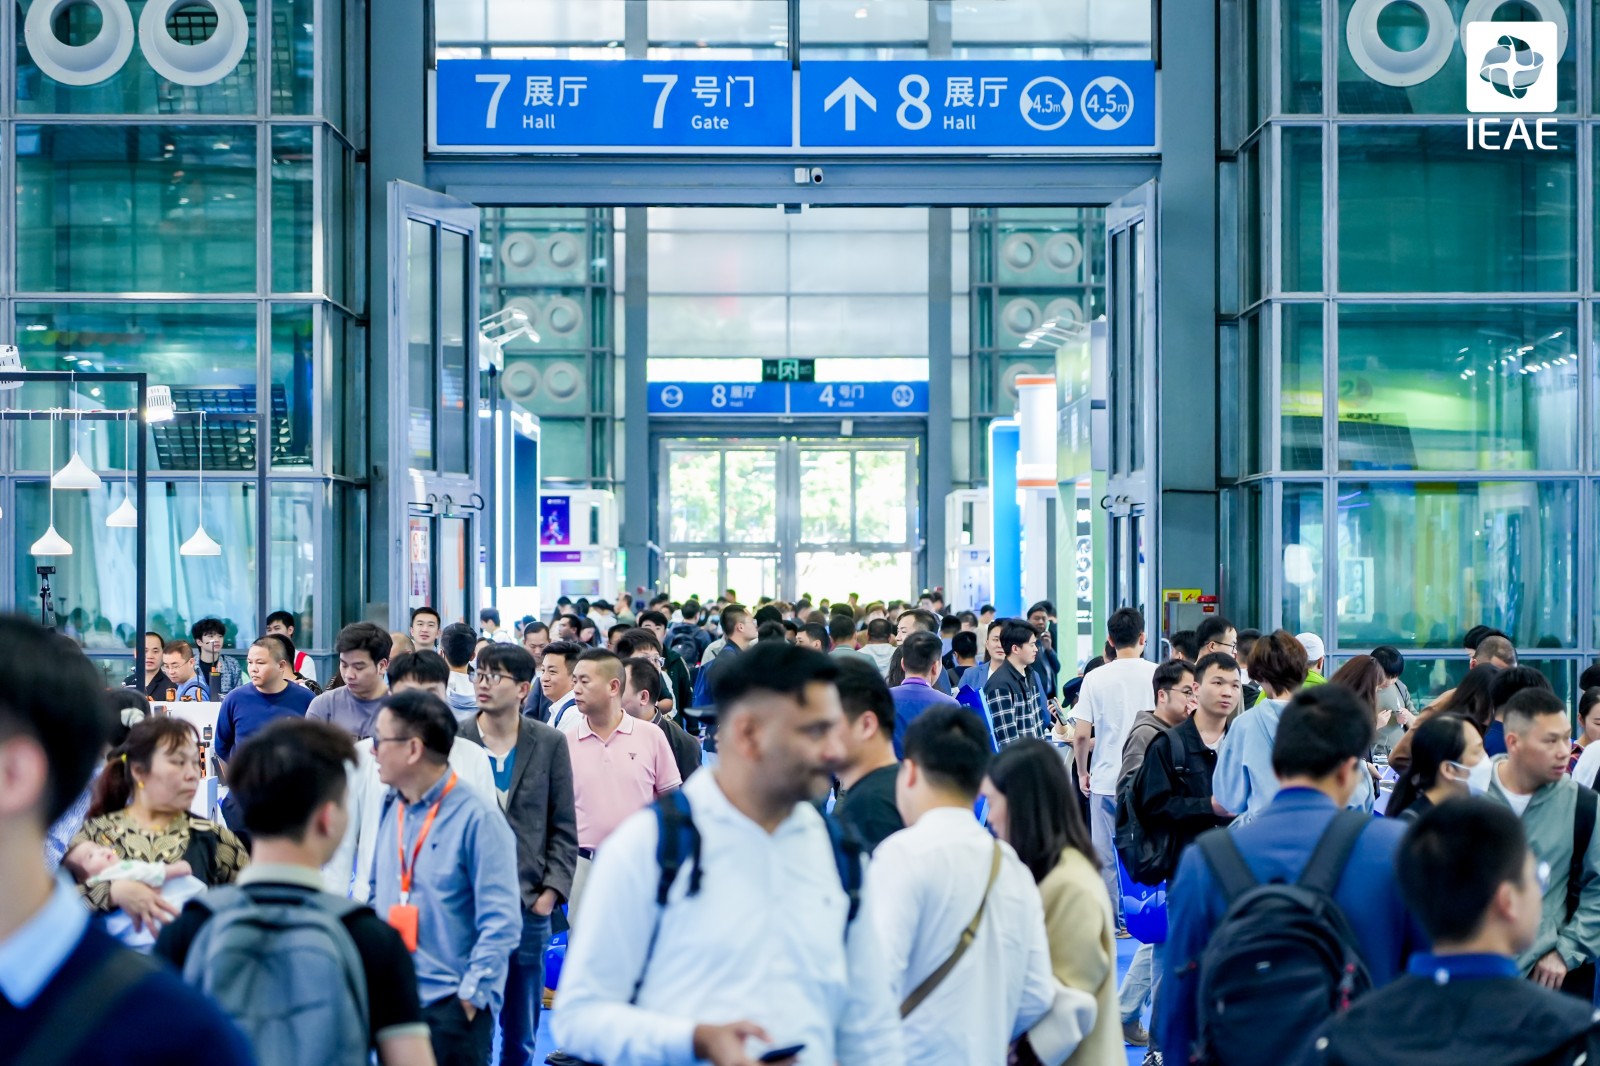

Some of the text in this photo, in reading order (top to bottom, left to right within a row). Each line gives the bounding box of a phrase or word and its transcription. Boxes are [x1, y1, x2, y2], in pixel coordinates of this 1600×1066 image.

[475, 74, 588, 129] 7 展厅
[642, 74, 754, 129] 7 号门
[896, 74, 1008, 131] 8 展厅
[1033, 94, 1061, 113] 4.5m
[1087, 94, 1128, 113] 4.5m
[523, 115, 555, 130] Hall
[691, 115, 730, 131] Gate
[943, 115, 976, 130] Hall
[711, 384, 727, 408] 8
[818, 384, 835, 408] 4
